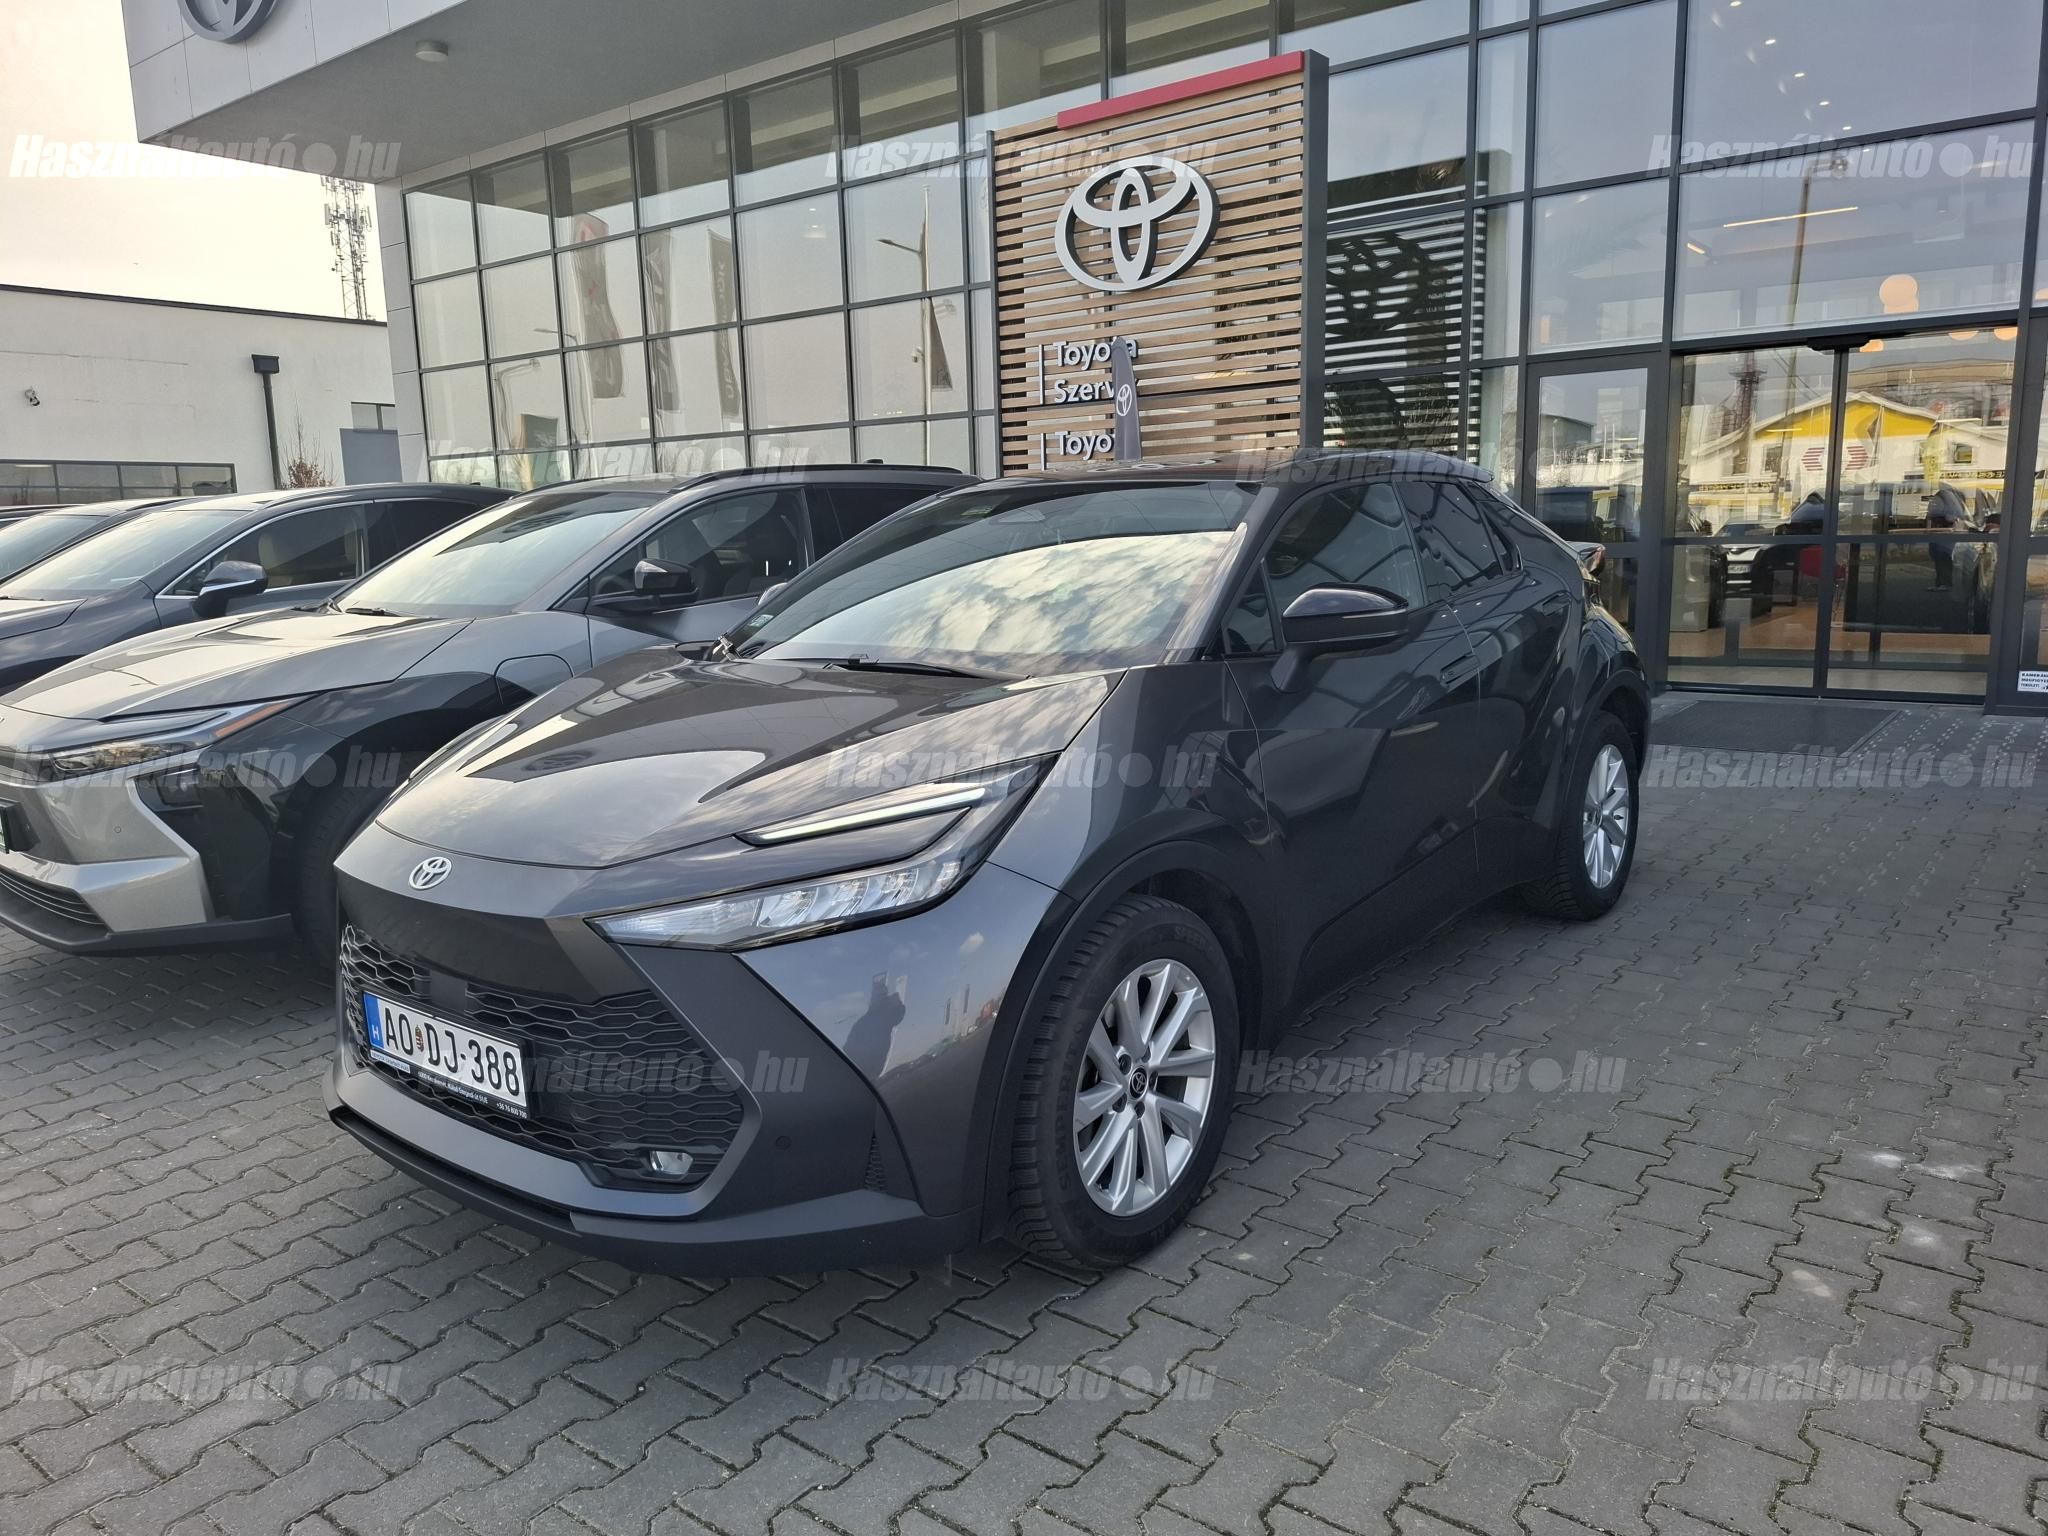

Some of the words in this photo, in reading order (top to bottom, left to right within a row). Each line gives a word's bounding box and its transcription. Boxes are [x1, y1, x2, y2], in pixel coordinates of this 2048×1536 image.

[1053, 336, 1137, 370] Toyoa
[1055, 379, 1137, 403] Szerv
[1055, 431, 1115, 460] Toyo
[372, 1023, 380, 1041] H
[385, 1007, 414, 1056] AO
[424, 1022, 520, 1097] DJ-388
